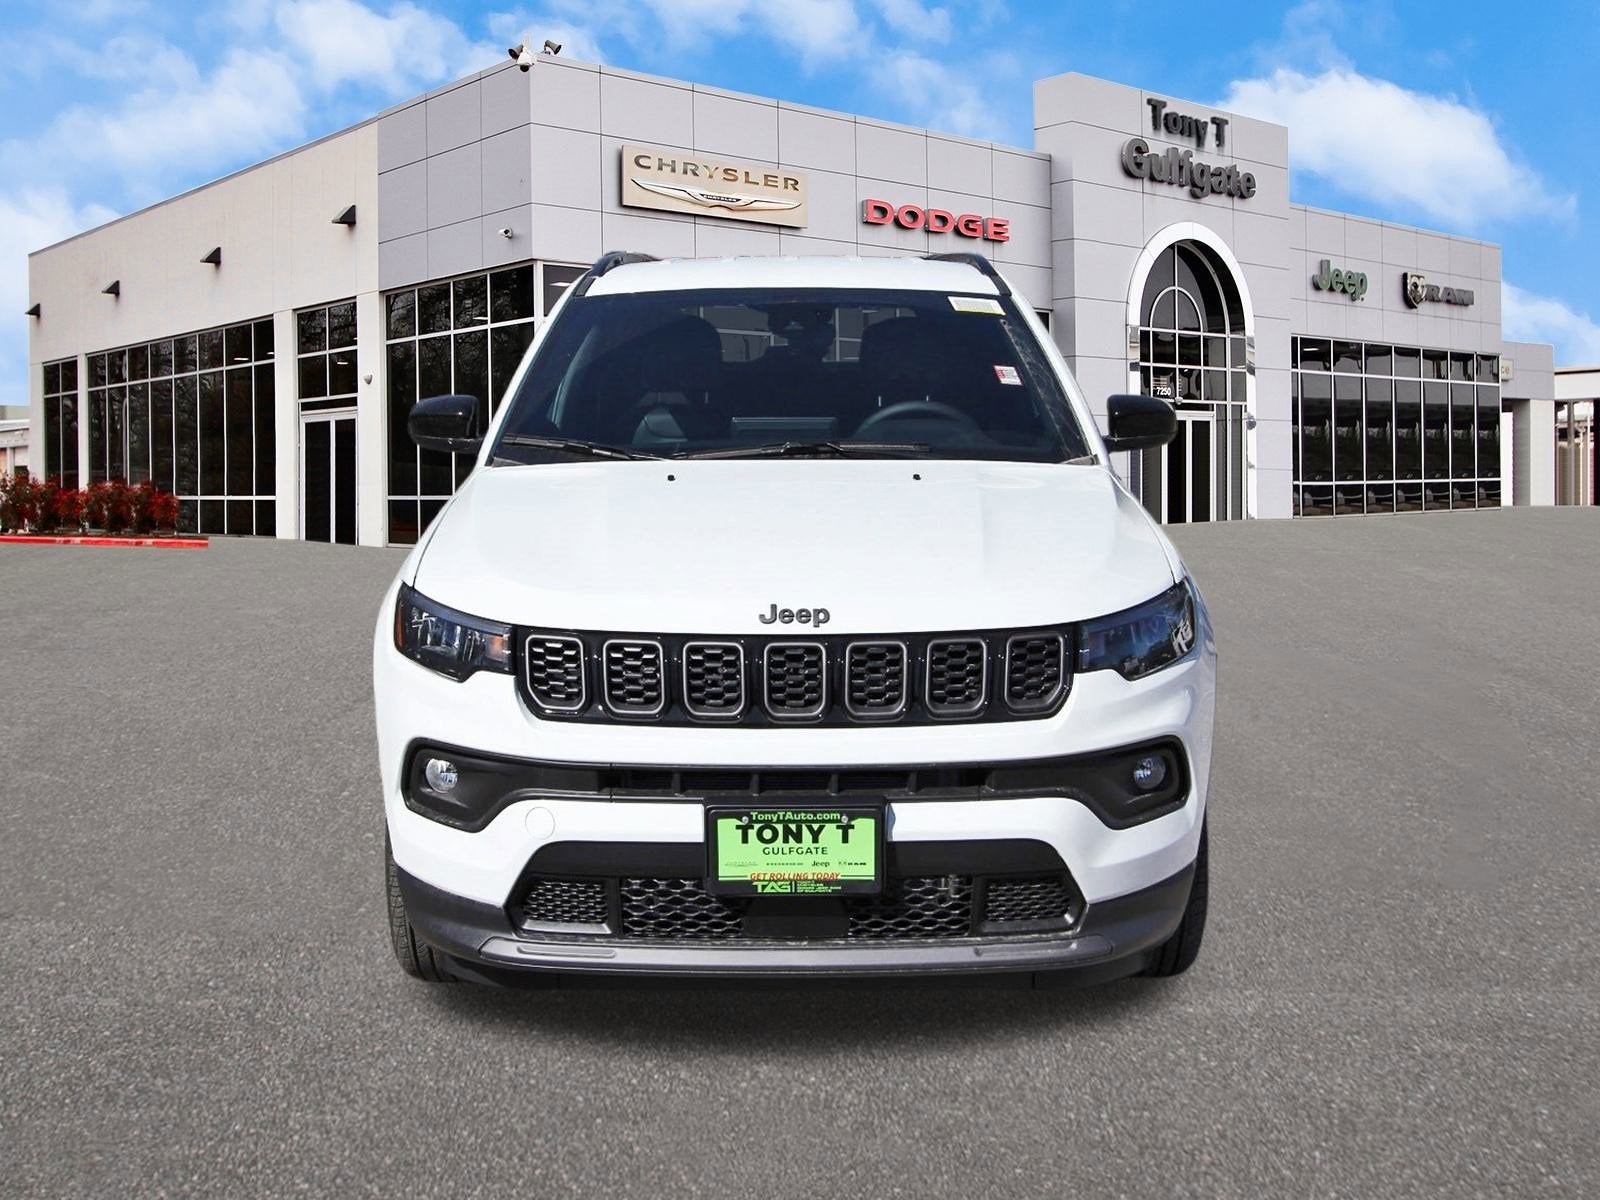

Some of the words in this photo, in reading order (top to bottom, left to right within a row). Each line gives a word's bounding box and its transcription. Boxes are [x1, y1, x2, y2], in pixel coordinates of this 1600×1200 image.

[1147, 97, 1208, 147] Tony
[1211, 117, 1229, 147] T
[634, 153, 801, 192] CHRYSLER
[1121, 138, 1257, 200] Gulfgate
[863, 197, 1011, 243] DODGE
[1312, 258, 1368, 303] Jeep
[1424, 283, 1475, 307] RAM
[758, 603, 831, 628] Jeep
[750, 811, 841, 822] TonyTAuto.com
[735, 823, 826, 845] TONY
[836, 823, 855, 844] T
[762, 846, 829, 856] GULFGATE
[811, 860, 831, 868] Jeep
[750, 872, 768, 881] GET
[769, 872, 808, 881] ROLLING
[811, 872, 841, 881] TODAY
